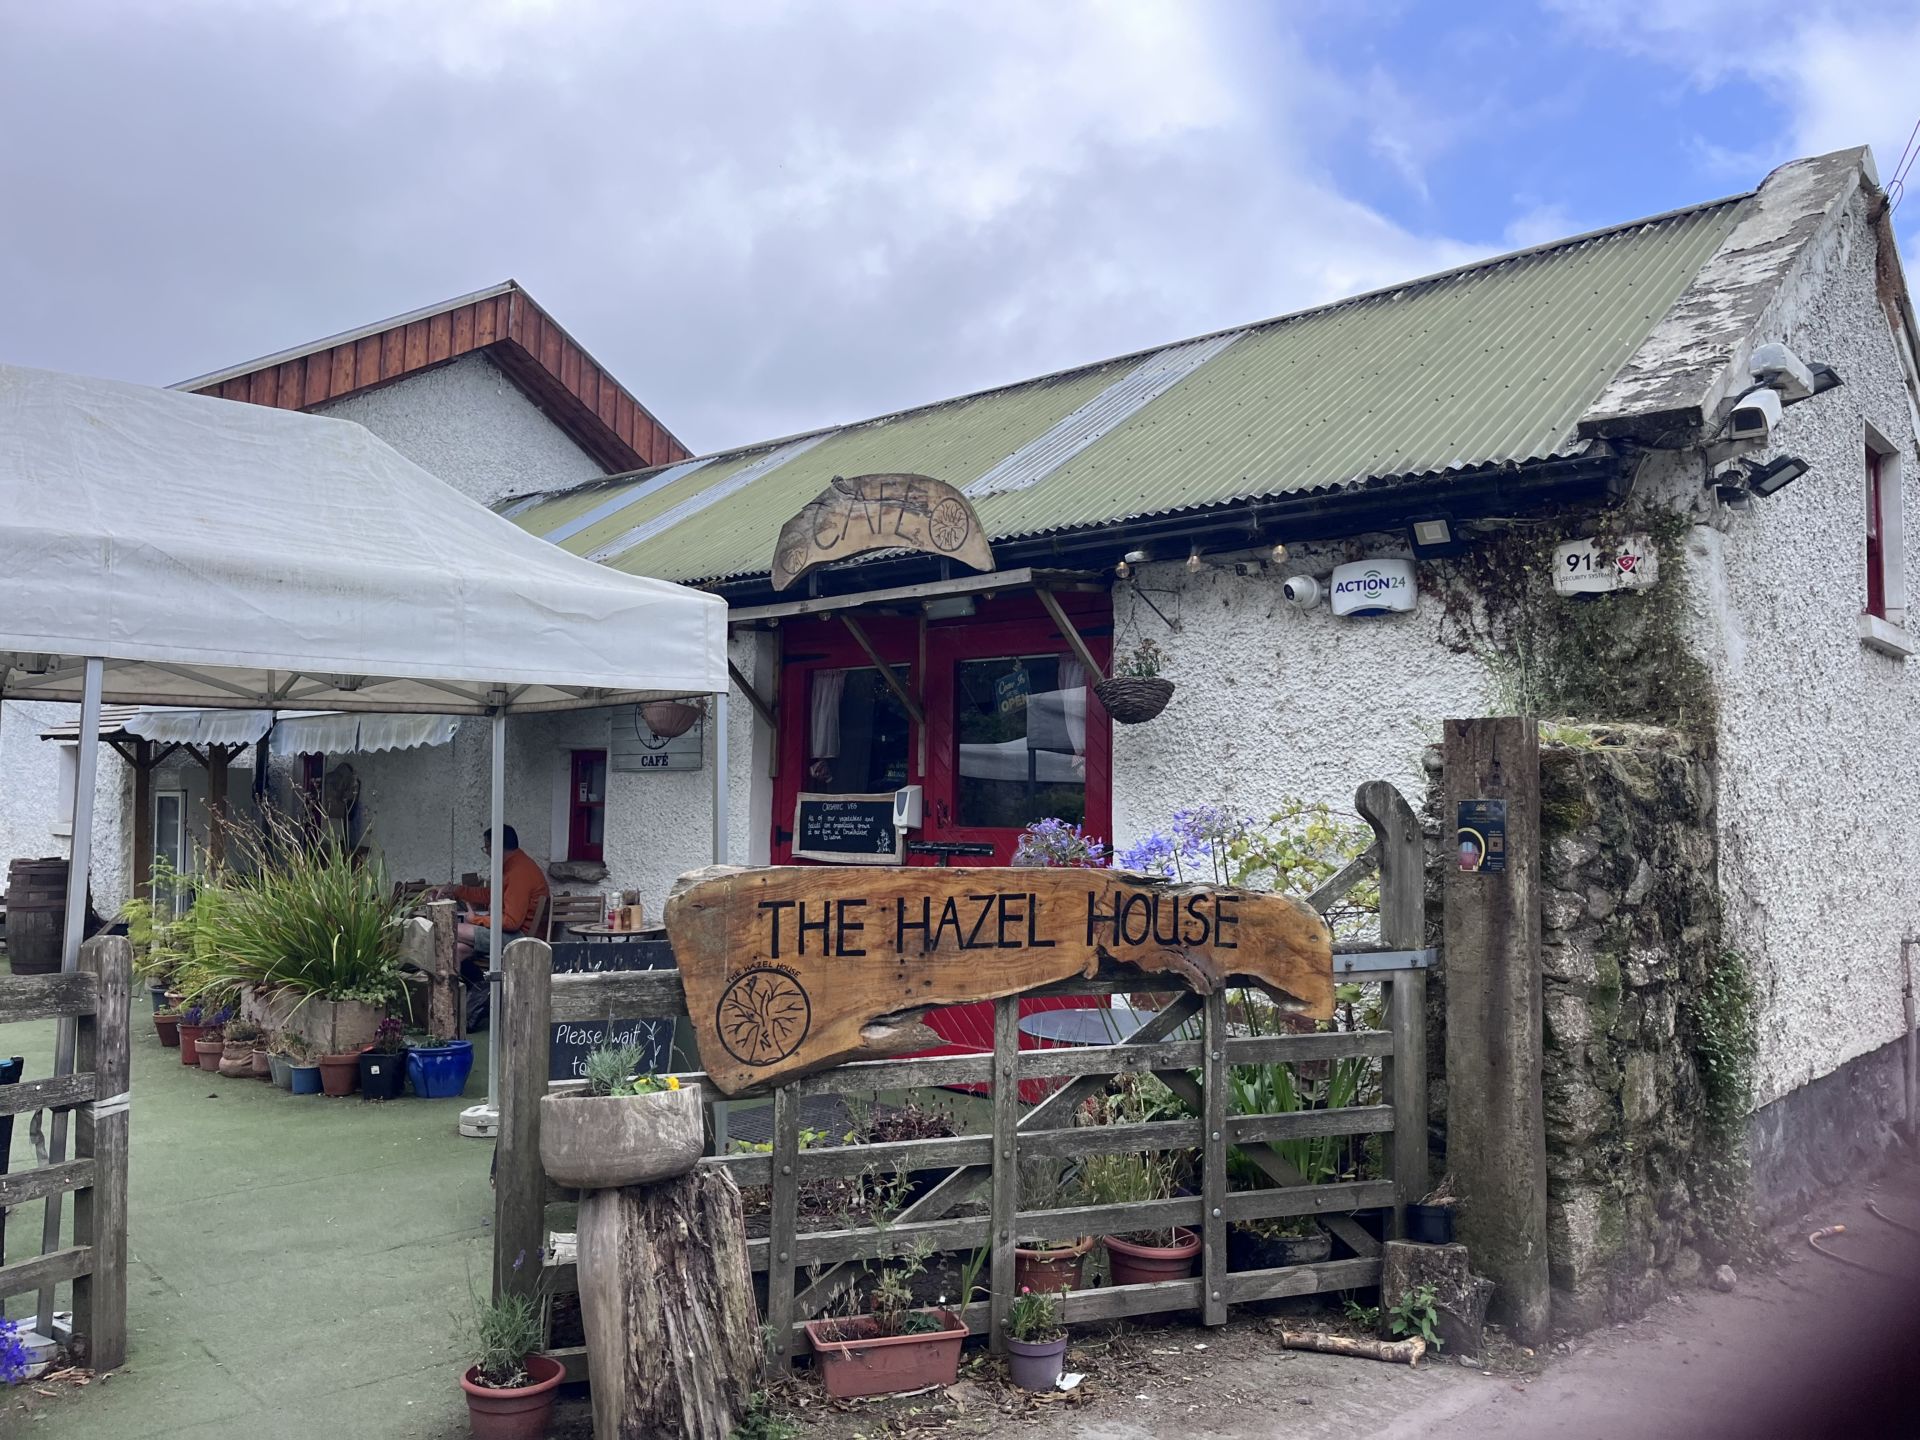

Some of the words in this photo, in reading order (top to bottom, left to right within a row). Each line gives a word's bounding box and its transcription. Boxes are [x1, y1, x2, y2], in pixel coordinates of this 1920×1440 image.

[641, 752, 669, 767] CAFÉ
[758, 898, 868, 959] THE
[896, 892, 1056, 954] HAZEL
[1086, 890, 1240, 949] HOUSE
[726, 970, 742, 984] THE
[743, 960, 773, 972] HAZEL
[776, 962, 802, 978] HOUSE
[556, 1024, 603, 1045] Please
[611, 1022, 641, 1045] wait
